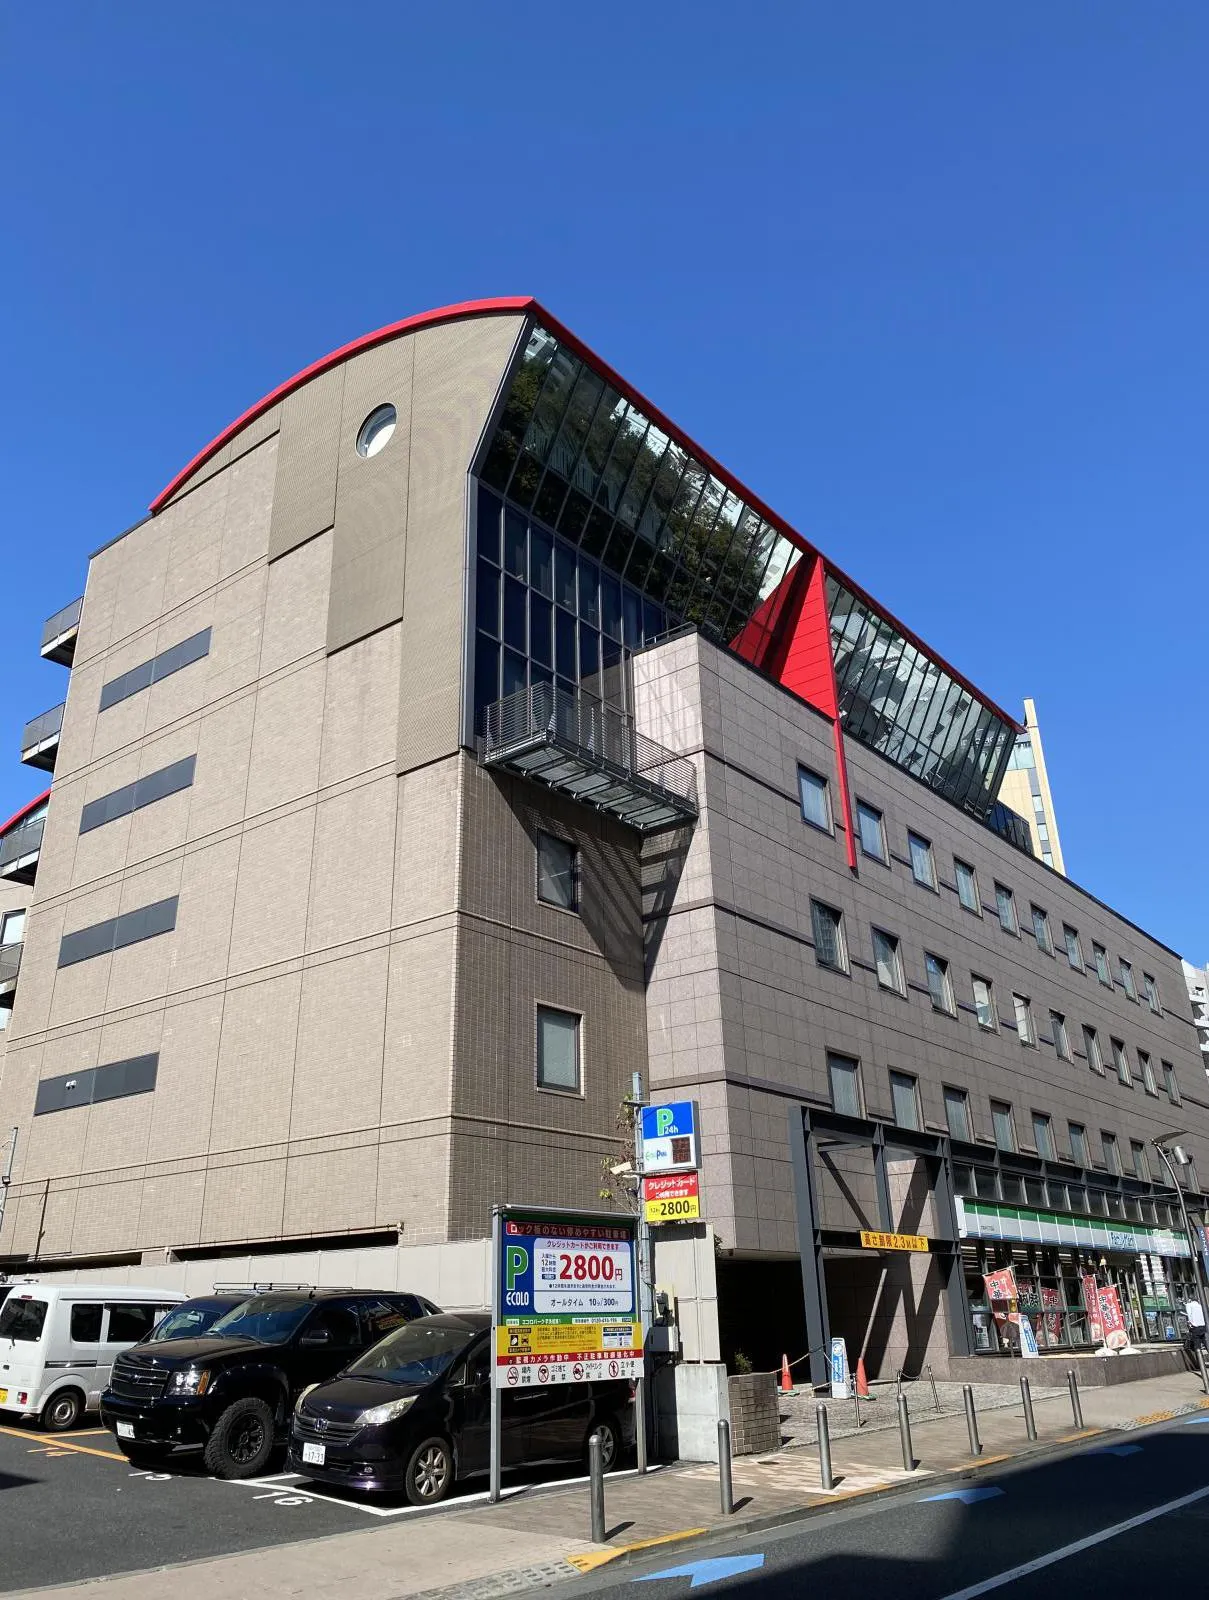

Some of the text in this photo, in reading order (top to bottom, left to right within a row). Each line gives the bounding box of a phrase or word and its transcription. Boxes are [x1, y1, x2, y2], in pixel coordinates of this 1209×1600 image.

[656, 1108, 674, 1137] P
[664, 1124, 679, 1135] 24h
[648, 1176, 696, 1191] クレジットカード
[546, 1241, 619, 1251] クレジットカードがご利用できます
[506, 1245, 529, 1291] P
[506, 1291, 530, 1306] ECOLO
[551, 1298, 584, 1307] オールタイム
[515, 1355, 569, 1364] 監視カメラ作動中
